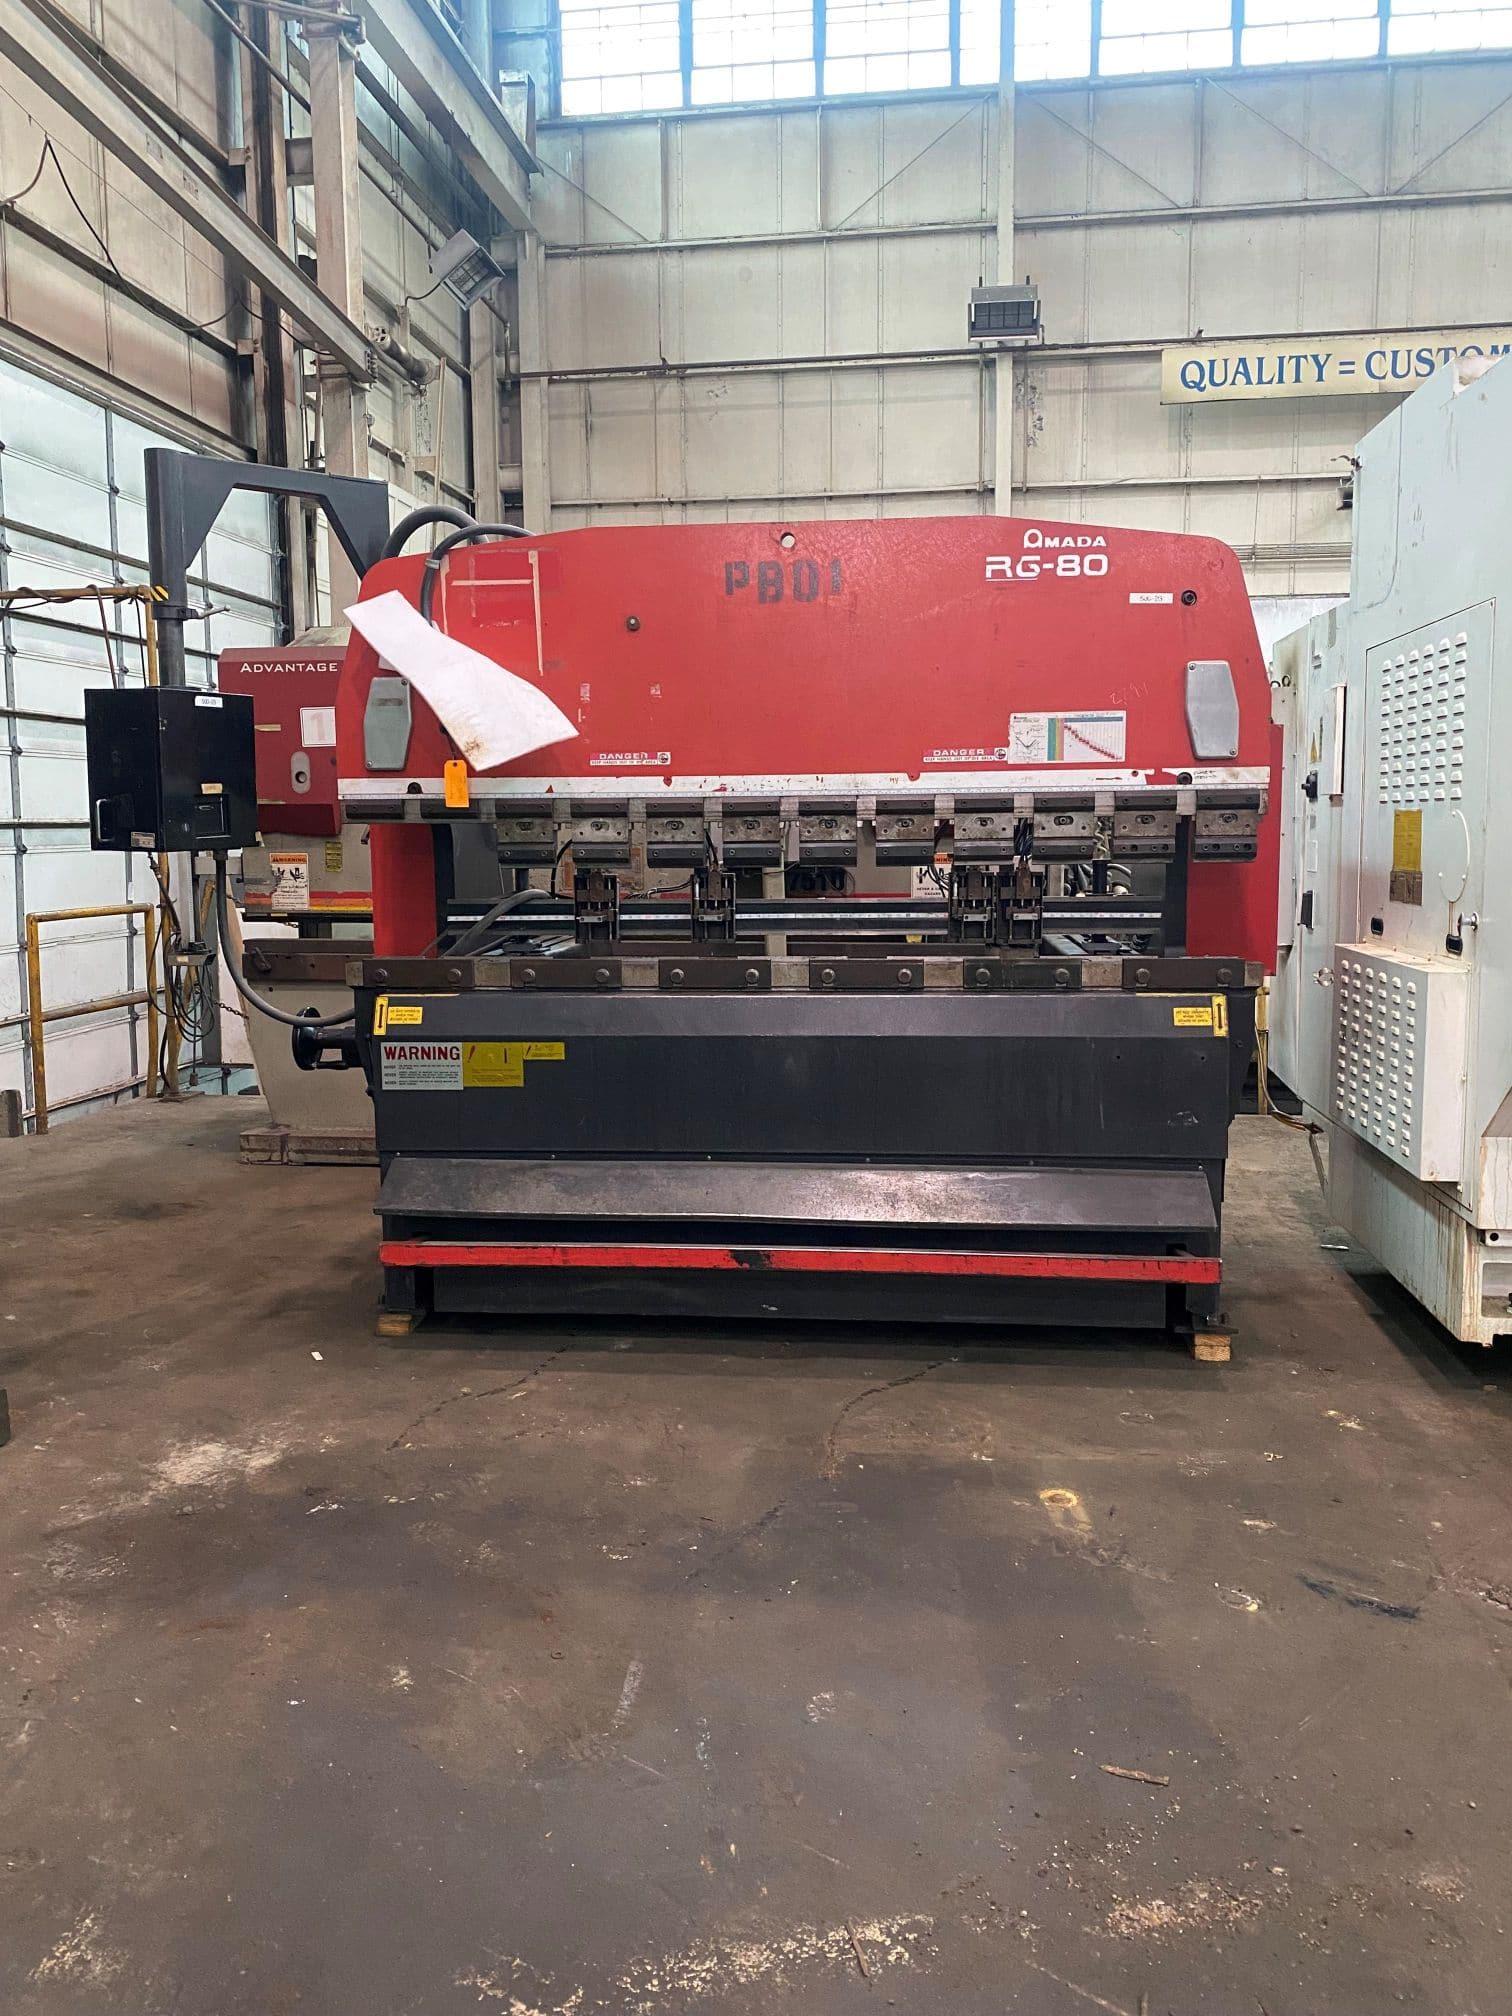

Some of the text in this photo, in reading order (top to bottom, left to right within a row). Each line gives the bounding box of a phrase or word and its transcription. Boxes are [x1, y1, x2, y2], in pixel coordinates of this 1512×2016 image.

[1180, 353, 1333, 393] QUALITY
[1365, 344, 1511, 380] CUST
[1023, 528, 1107, 549] AMADA
[985, 553, 1109, 579] RG-80
[239, 662, 338, 673] ADVANTAGE
[599, 752, 648, 760] DANGER
[932, 748, 985, 757] DANGER
[383, 1045, 461, 1061] WARNING
